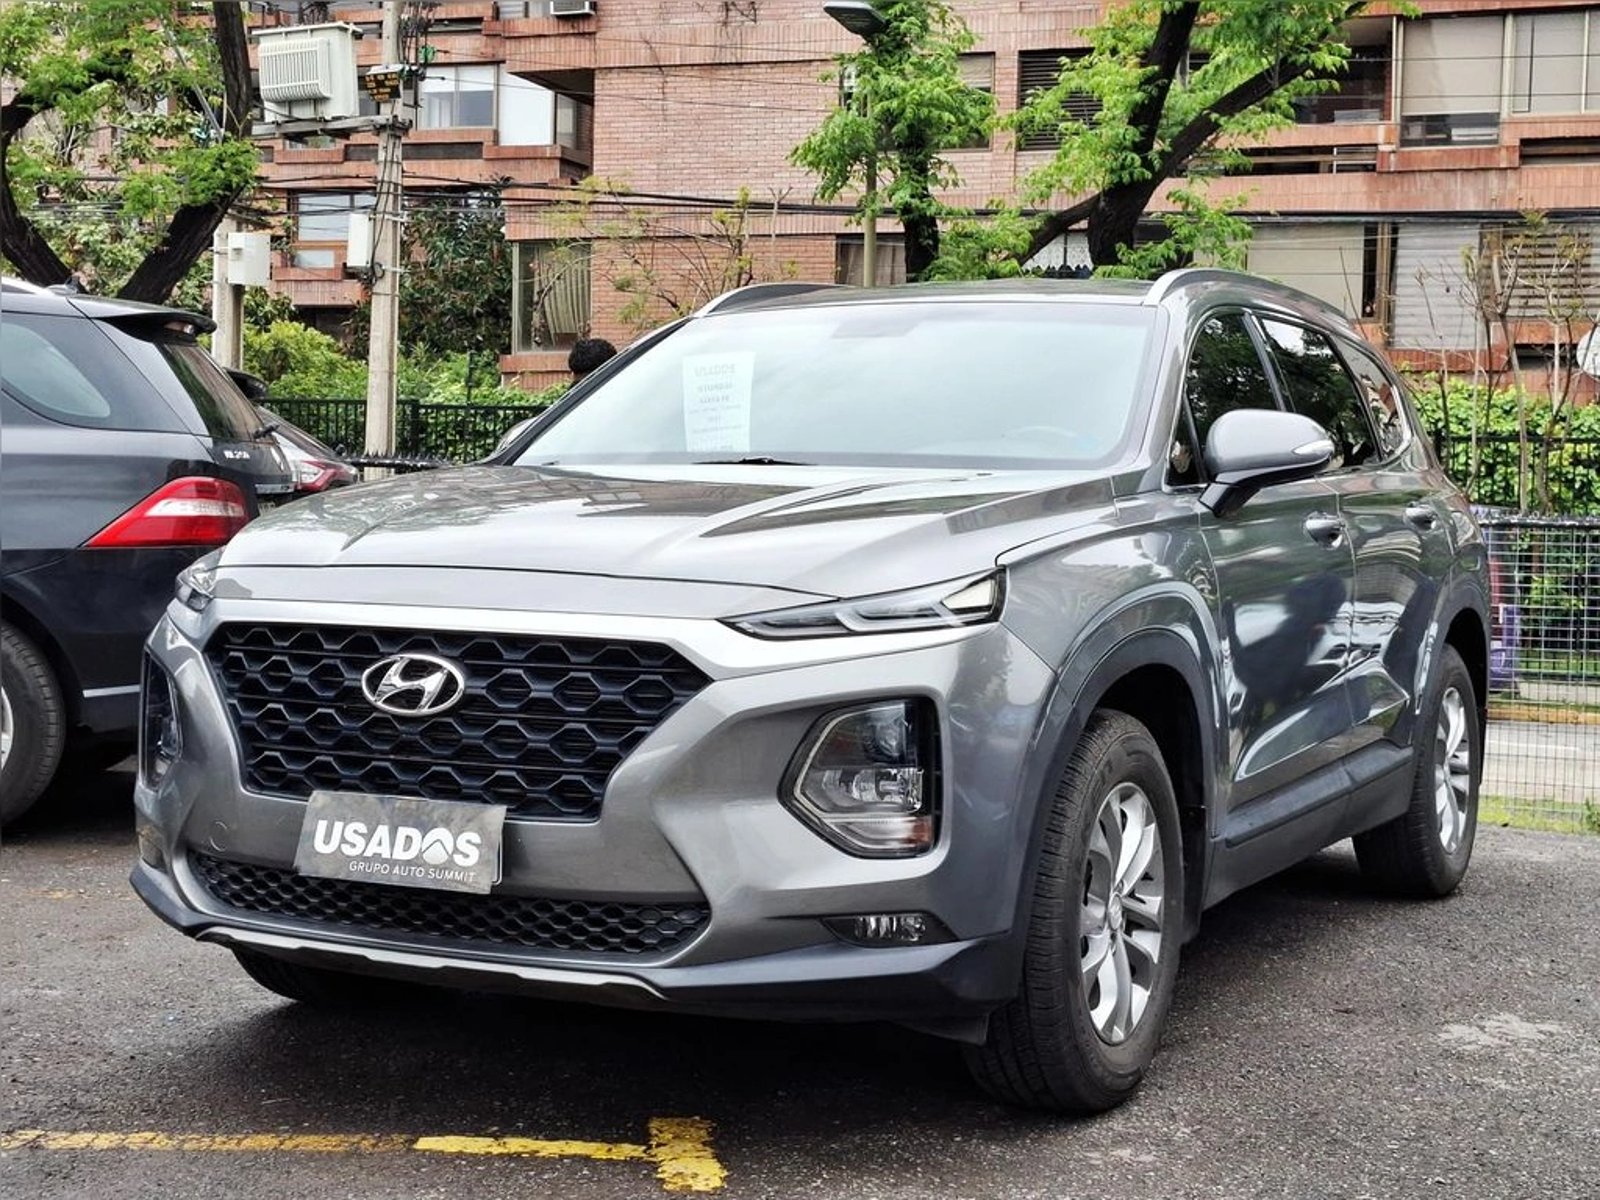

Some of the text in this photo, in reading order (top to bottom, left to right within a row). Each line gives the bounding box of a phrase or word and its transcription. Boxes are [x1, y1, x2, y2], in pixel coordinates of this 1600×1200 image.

[313, 819, 482, 867] USADOS
[349, 860, 477, 882] GRUPO AUTO SUMMIT
